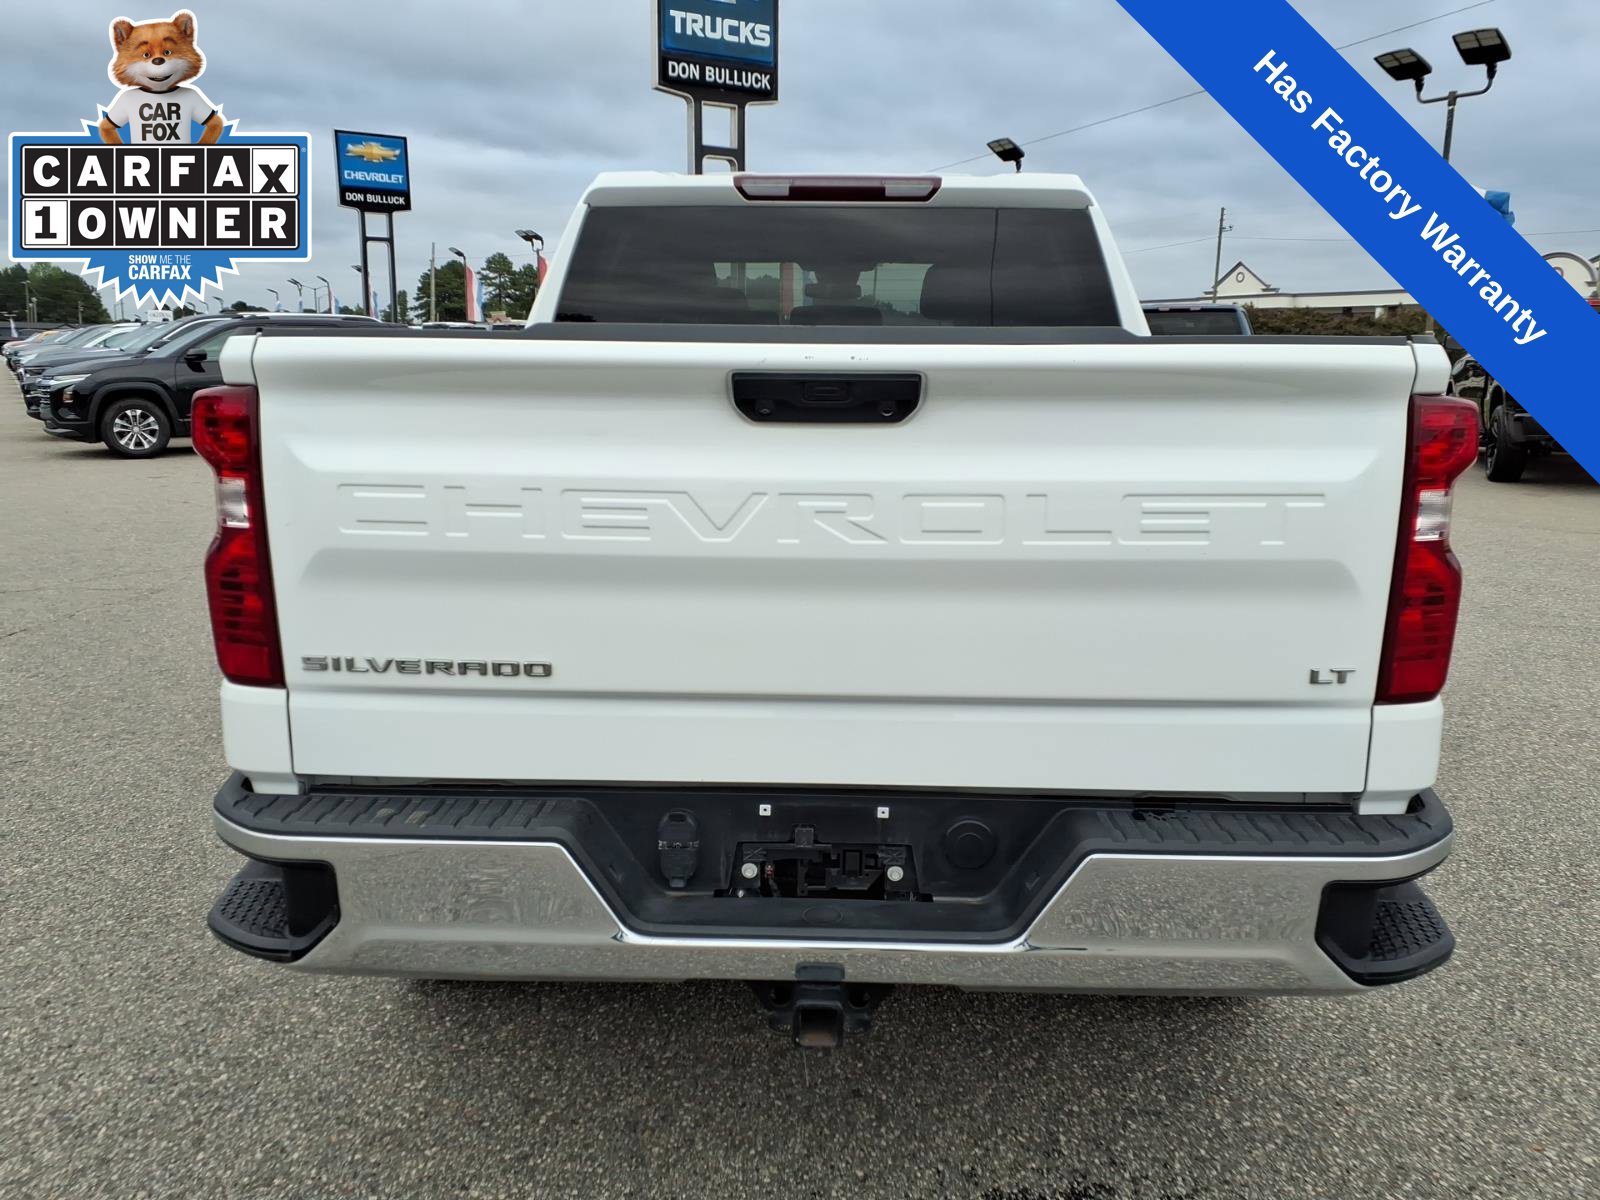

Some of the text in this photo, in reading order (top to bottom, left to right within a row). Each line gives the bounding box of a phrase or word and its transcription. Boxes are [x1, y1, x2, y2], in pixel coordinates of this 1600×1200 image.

[670, 10, 770, 47] TRUCKS
[668, 61, 771, 90] DON BULLUCK
[344, 170, 404, 184] CHEVROLET
[345, 192, 405, 205] DON BULLUCK
[338, 483, 1326, 547] CHEVROLET
[301, 655, 553, 678] SILVERADO
[1309, 667, 1357, 686] LT
